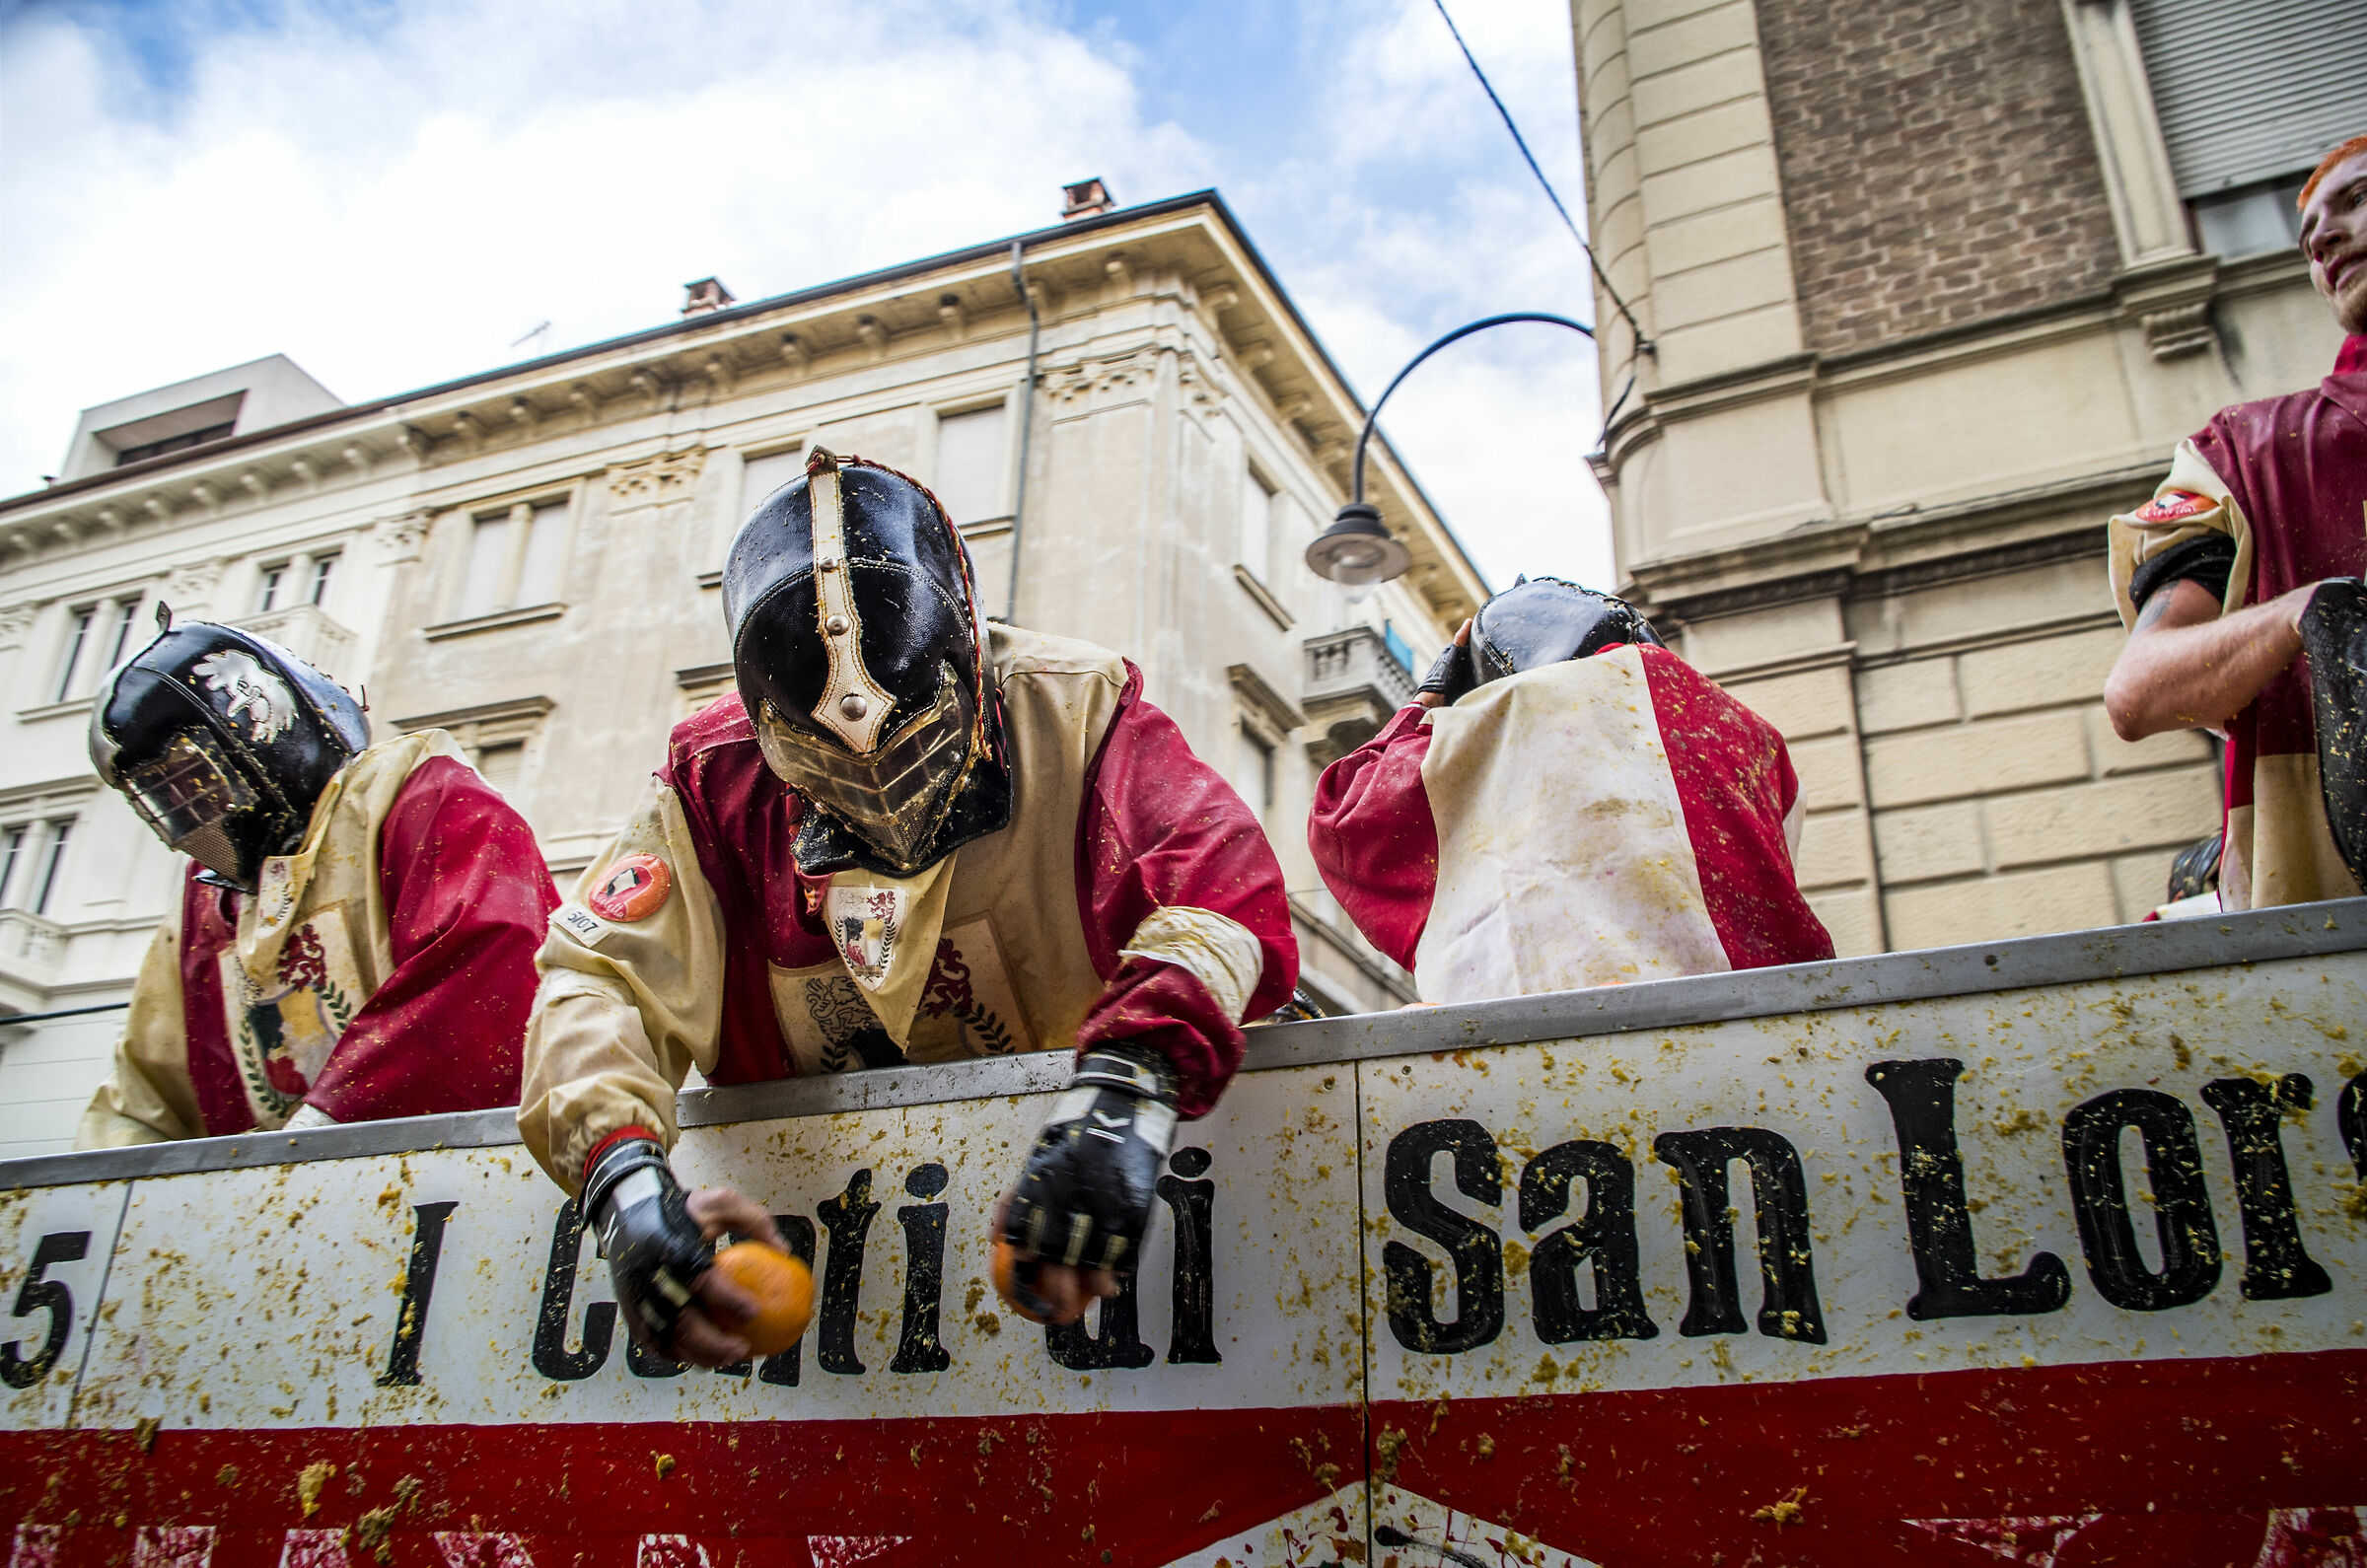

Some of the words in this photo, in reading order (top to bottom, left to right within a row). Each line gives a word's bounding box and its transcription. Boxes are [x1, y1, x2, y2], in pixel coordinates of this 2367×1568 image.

[0, 1230, 91, 1389] 5
[377, 1201, 459, 1386] I
[533, 1163, 951, 1387] Cti
[1383, 1118, 1828, 1355] San
